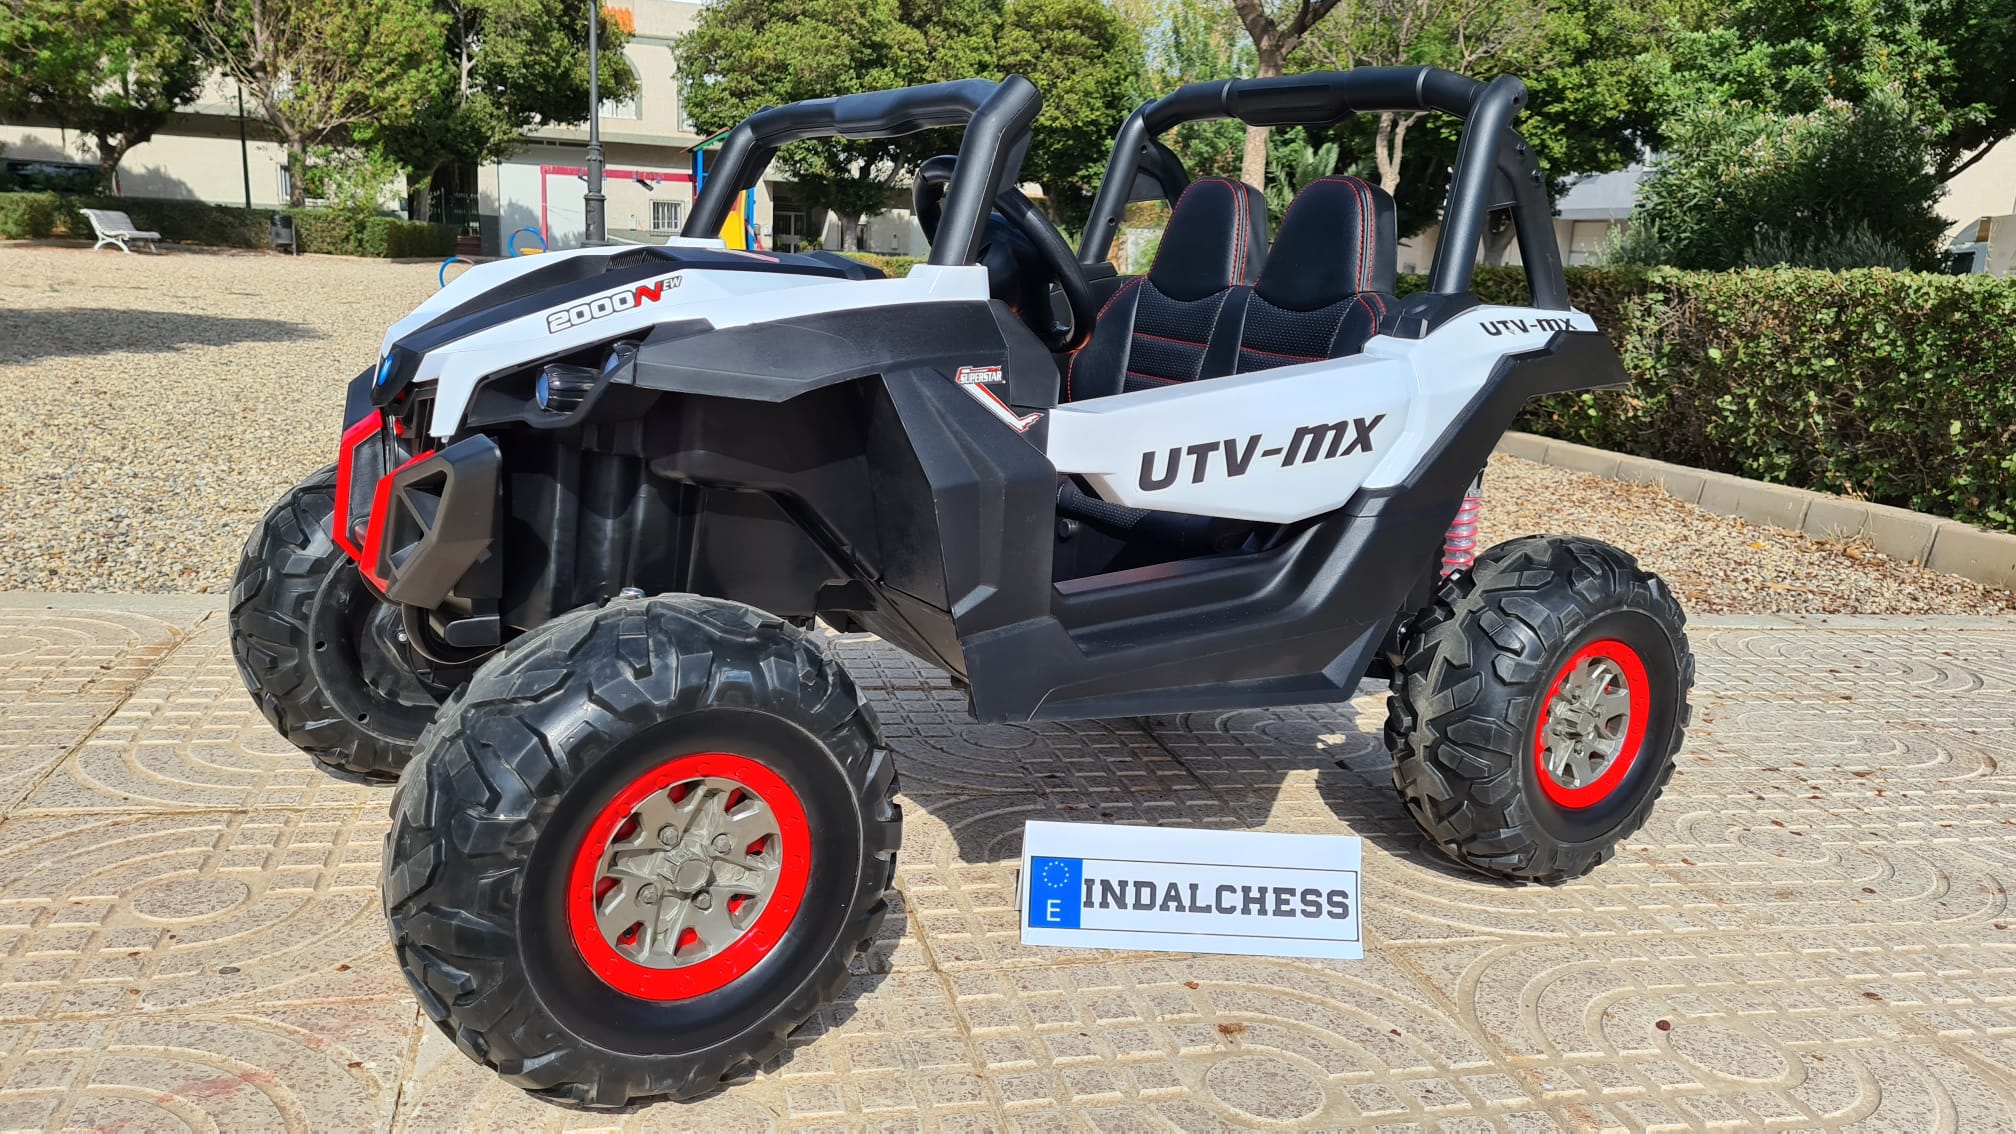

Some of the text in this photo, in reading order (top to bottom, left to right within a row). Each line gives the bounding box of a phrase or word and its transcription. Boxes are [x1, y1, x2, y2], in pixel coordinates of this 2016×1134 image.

[959, 371, 1002, 384] SUPERSTAR
[1046, 899, 1061, 922] E
[1083, 878, 1350, 920] INDALCHESS
